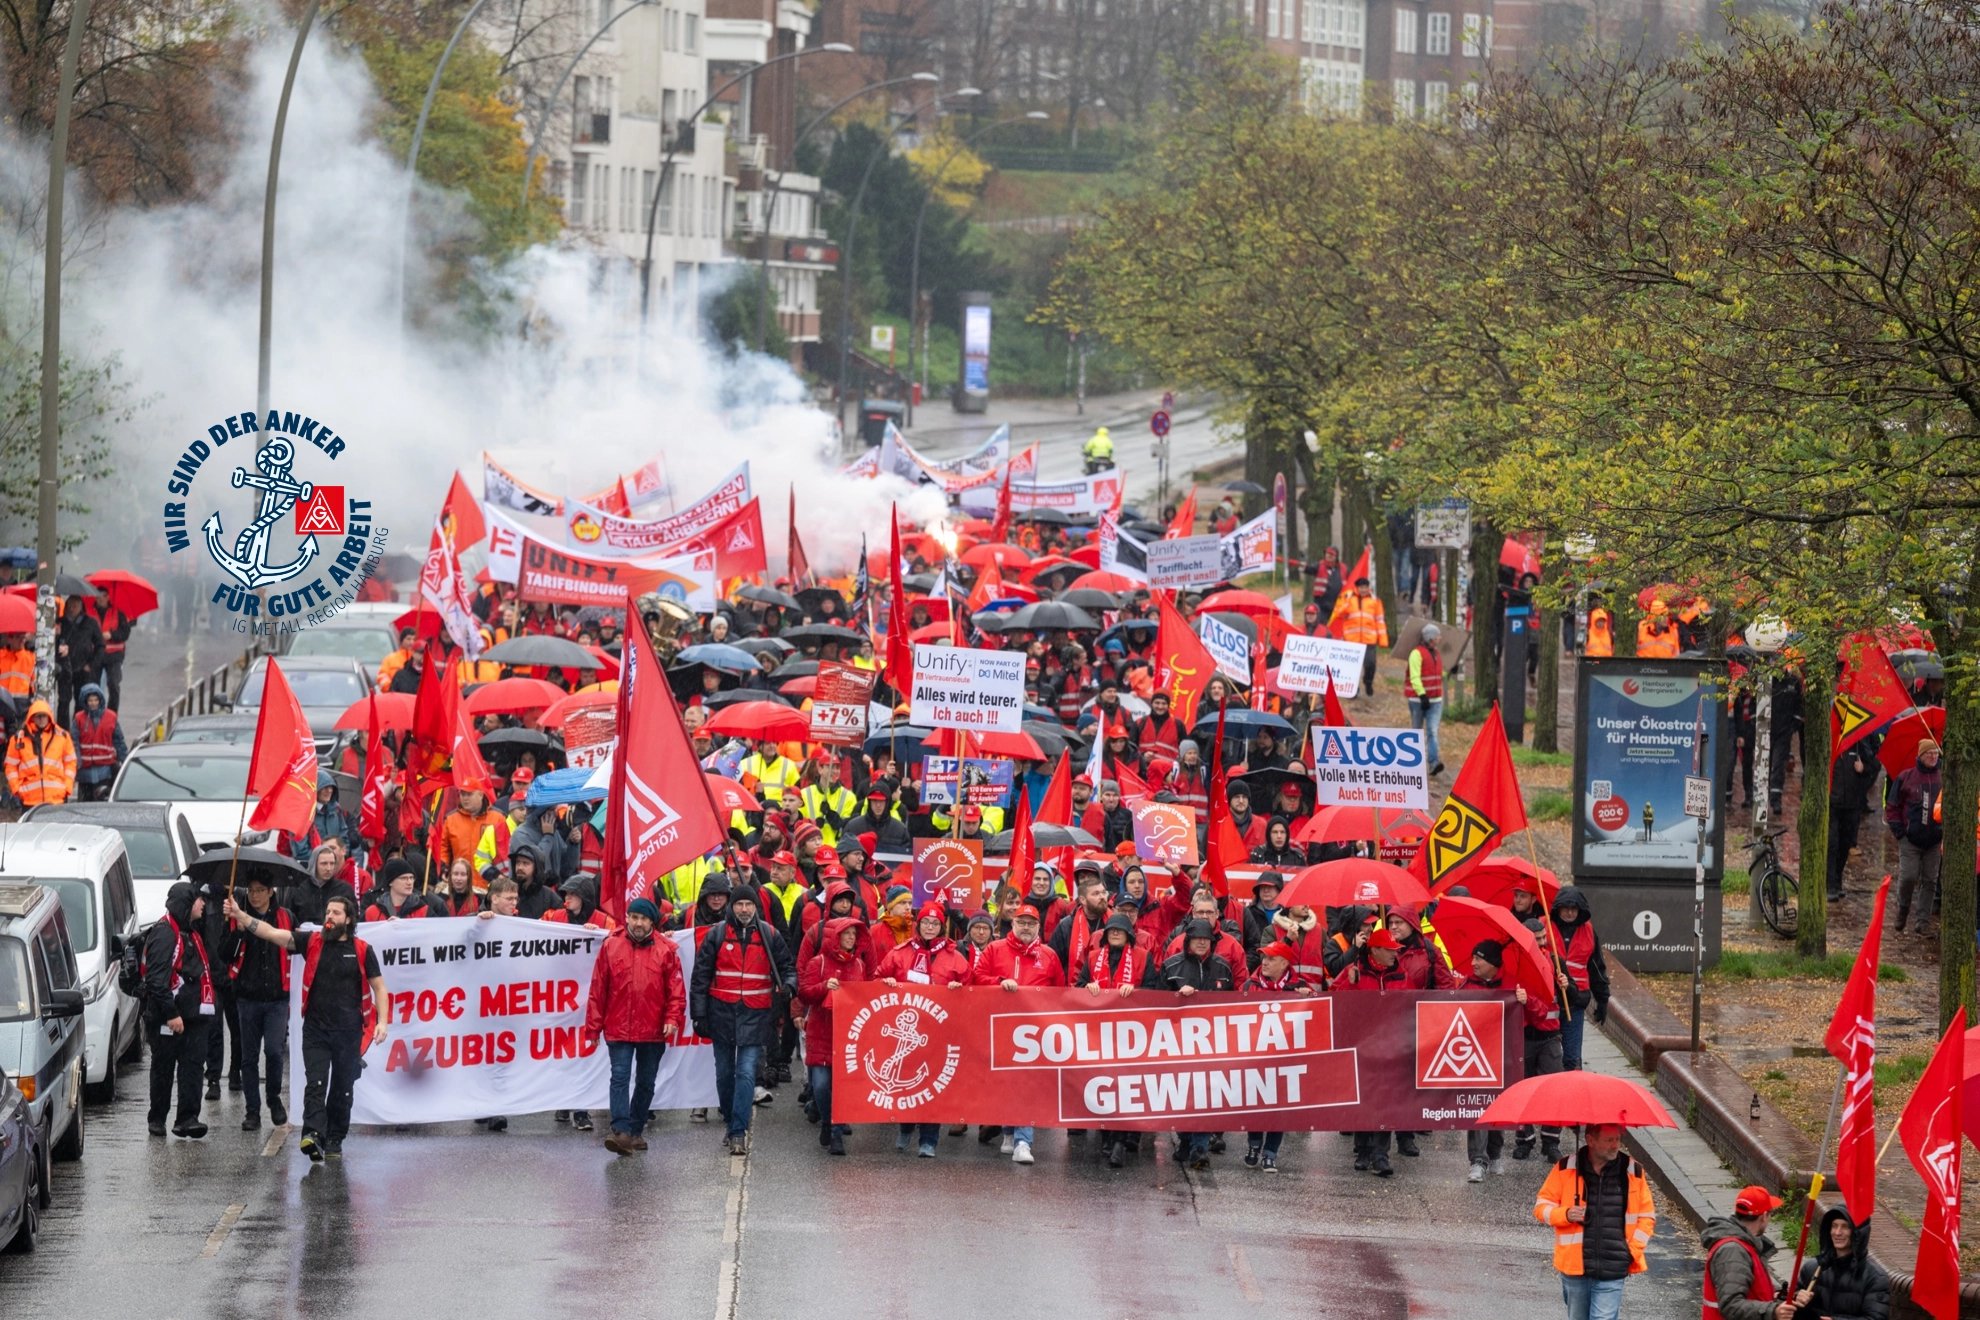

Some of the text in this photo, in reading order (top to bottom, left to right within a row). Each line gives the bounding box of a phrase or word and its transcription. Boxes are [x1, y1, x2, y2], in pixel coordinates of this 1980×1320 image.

[1148, 543, 1182, 556] Unify
[528, 544, 617, 582] UNIFY
[526, 572, 628, 596] TARIFBINDUNG
[1151, 576, 1174, 586] Nicht
[1177, 573, 1191, 582] mit
[1202, 618, 1247, 658] Atos
[1286, 640, 1323, 657] Unify
[917, 652, 967, 676] Unify
[993, 669, 1019, 680] Mitel
[1281, 674, 1354, 694] Nicht mit ns!!!
[916, 686, 1017, 708] Alles wird teurer.
[818, 708, 859, 725] +7%
[933, 706, 951, 720] Ich
[955, 709, 983, 723] auch
[1597, 716, 1706, 730] Unser Ökostrom
[1316, 730, 1422, 767] Atos
[1606, 733, 1695, 747] für Hamburg.
[1319, 768, 1422, 790] Volle M+E Erhöhung
[1690, 782, 1706, 791] Parken
[1338, 786, 1406, 803] Auch für uns!
[1598, 809, 1615, 818] 200
[917, 841, 978, 865] #ichbinFahrtreppe
[382, 937, 595, 966] WEIL WIR DIE ZUKUNFT
[1602, 943, 1631, 951] dtplan
[1652, 944, 1706, 952] Knopfdruk
[387, 979, 579, 1024] 170€ MEHR
[846, 992, 949, 1074] WIR SIND DER ANKER
[1012, 1002, 1313, 1062] SOLIDARITÄT
[386, 1025, 599, 1073] AZUBIS UND
[867, 1044, 960, 1110] FÜR GUTE ARBEIT
[1084, 1064, 1307, 1114] GEWINNT
[1457, 1094, 1465, 1105] IG
[1422, 1108, 1456, 1121] Region
